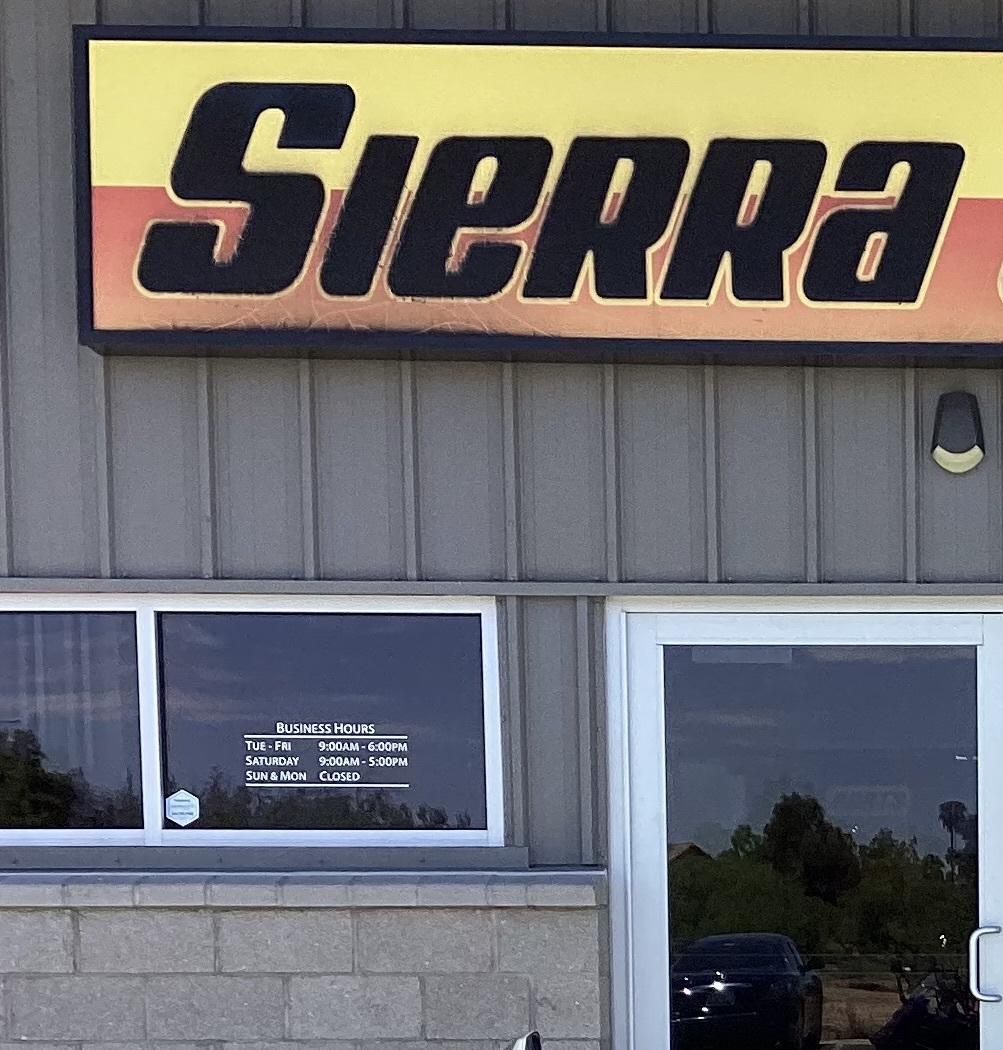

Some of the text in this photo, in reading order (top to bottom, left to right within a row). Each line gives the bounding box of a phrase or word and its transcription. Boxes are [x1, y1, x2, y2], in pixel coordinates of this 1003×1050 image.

[318, 741, 360, 752] 9:00AM
[368, 741, 408, 752] 6:00PM
[318, 756, 360, 767] 9:00AM
[368, 756, 409, 767] 5:00PM
[271, 771, 279, 781] &
